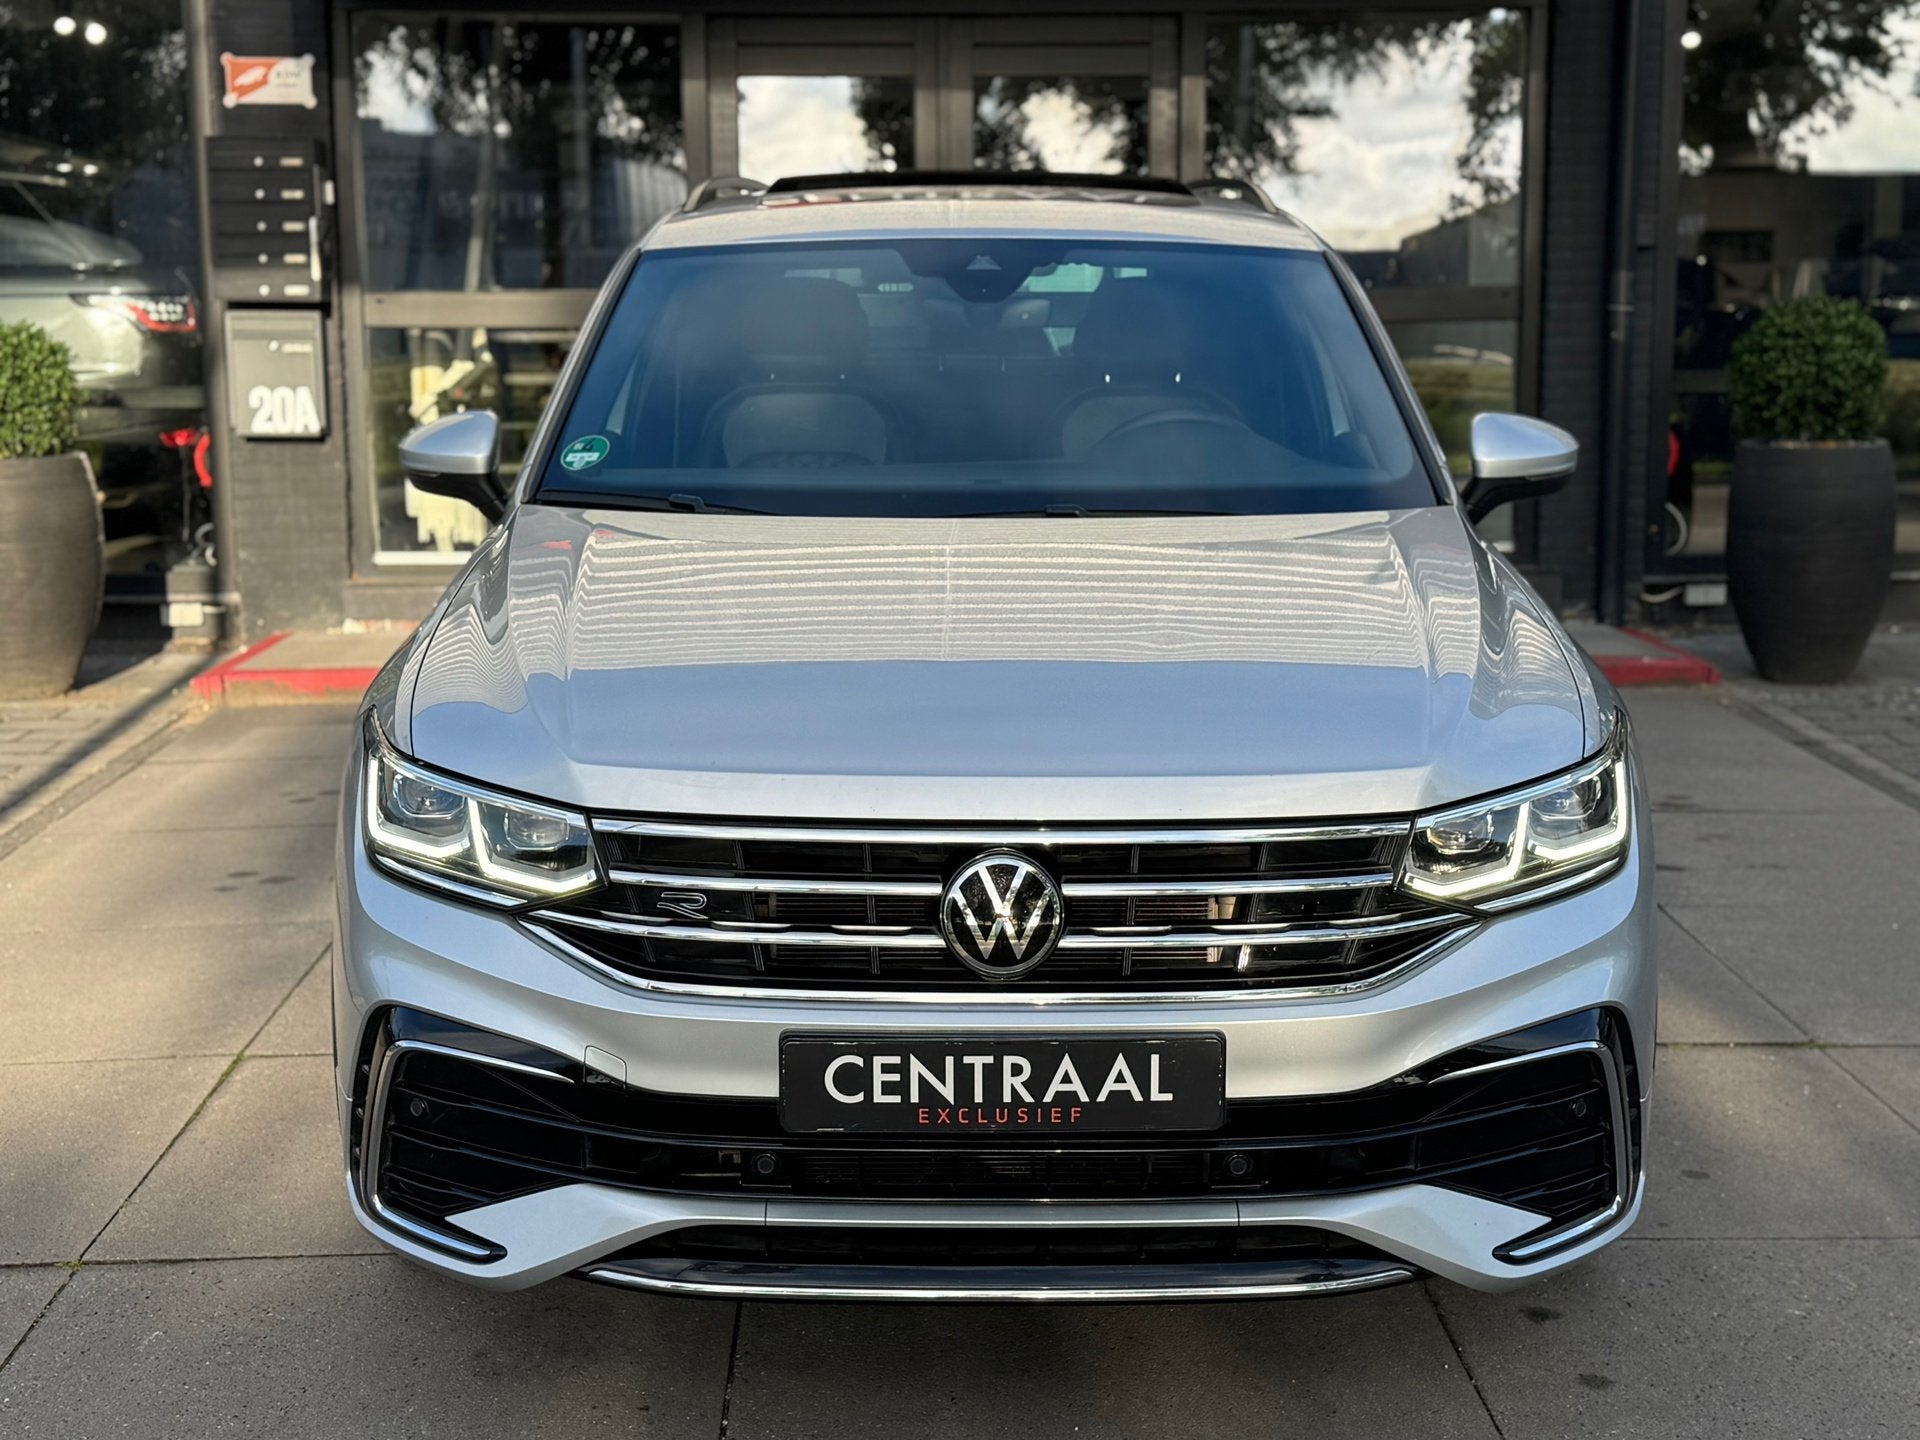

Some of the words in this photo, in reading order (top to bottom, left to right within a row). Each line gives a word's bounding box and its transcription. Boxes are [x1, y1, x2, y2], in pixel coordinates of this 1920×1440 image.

[248, 385, 321, 434] 20A
[657, 891, 709, 919] R
[823, 1052, 1174, 1105] CENTRAAL
[919, 1107, 1082, 1124] EXCLUSIEF
